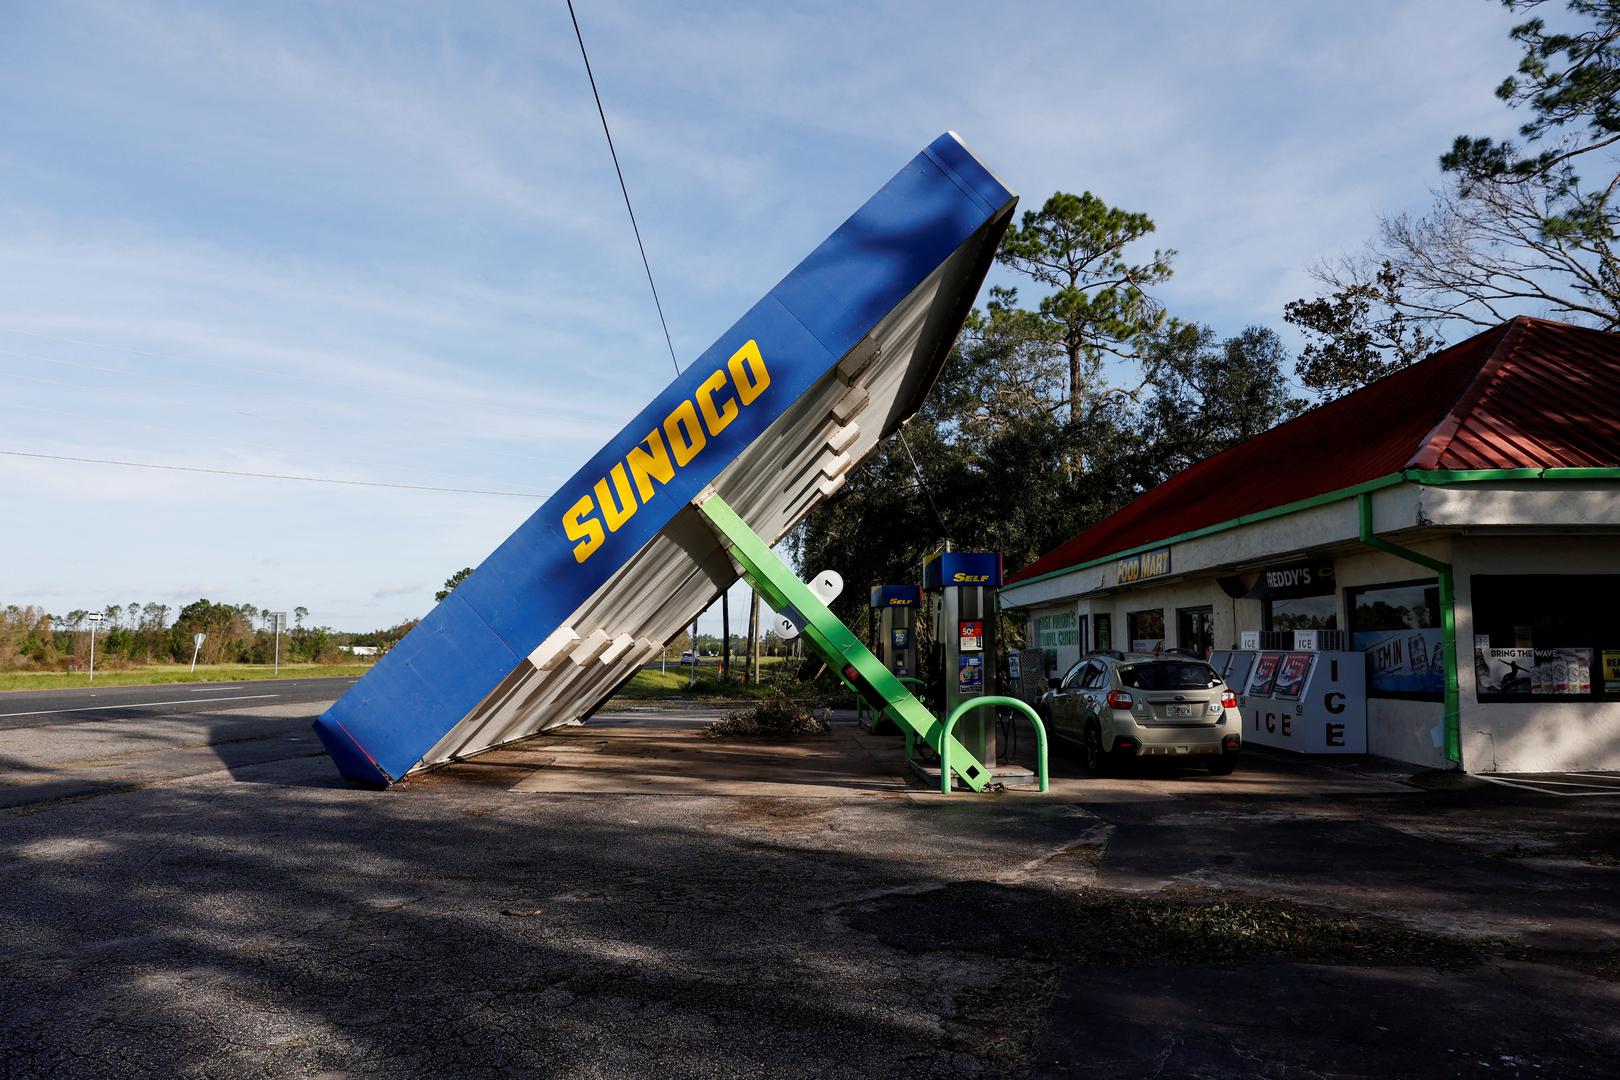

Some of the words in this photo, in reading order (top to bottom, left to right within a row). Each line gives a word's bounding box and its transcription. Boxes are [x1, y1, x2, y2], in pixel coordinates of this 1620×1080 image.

[562, 339, 771, 563] SUNOCO
[1117, 558, 1139, 584] FOOD
[1141, 552, 1169, 578] MART
[953, 572, 989, 583] SELF
[825, 579, 833, 587] 1
[888, 597, 913, 605] SELF
[782, 620, 792, 630] 2
[1244, 640, 1255, 648] ICE
[1299, 640, 1312, 649] ICE
[1393, 639, 1402, 665] IN
[1491, 650, 1516, 658] BRING
[1323, 659, 1346, 747] ICE
[1256, 710, 1291, 737] ICE
